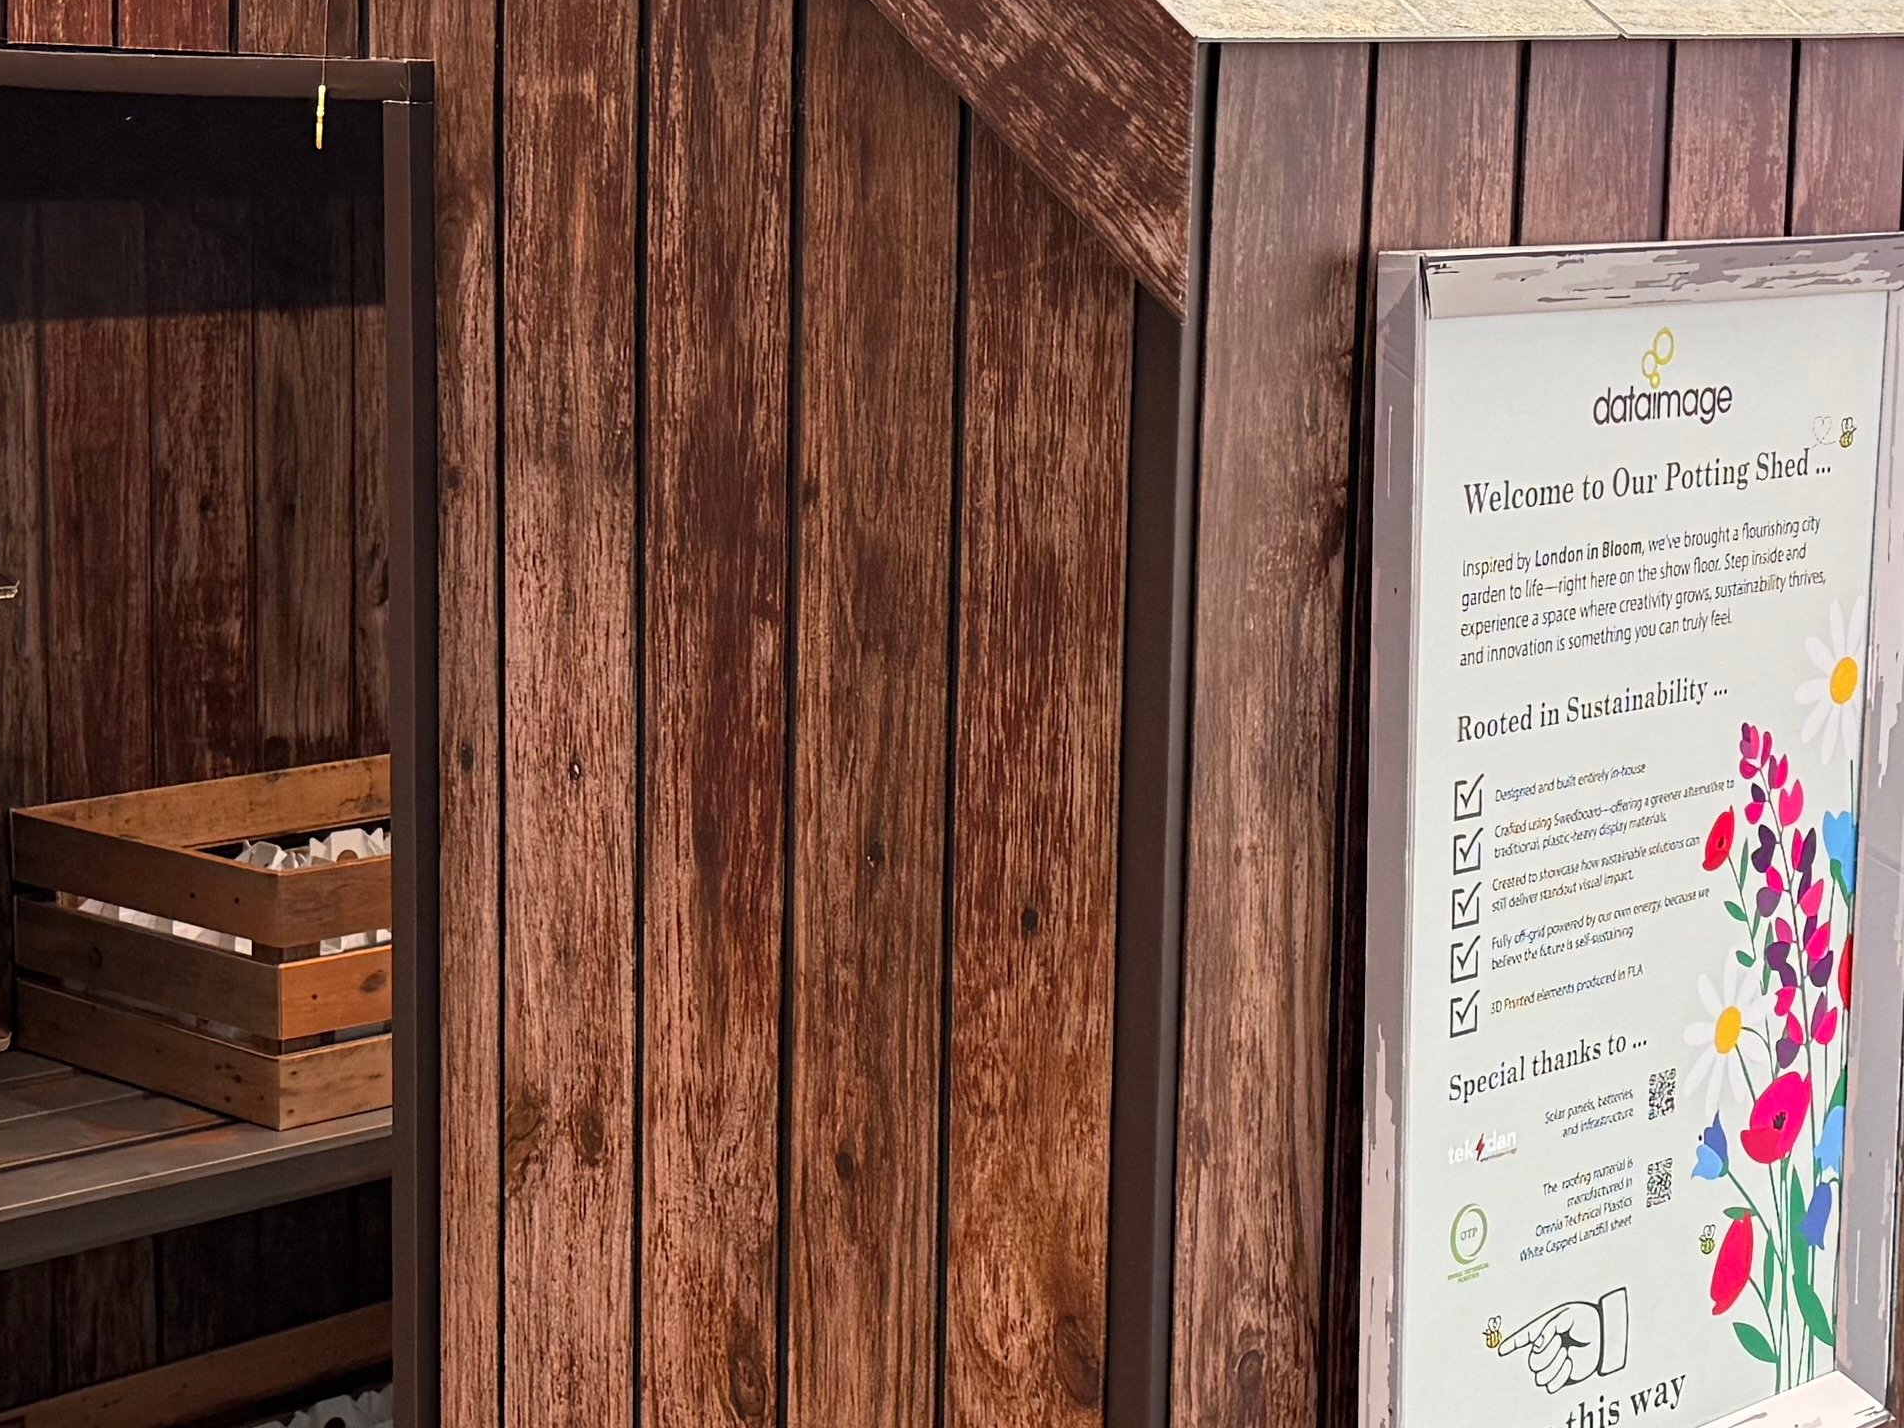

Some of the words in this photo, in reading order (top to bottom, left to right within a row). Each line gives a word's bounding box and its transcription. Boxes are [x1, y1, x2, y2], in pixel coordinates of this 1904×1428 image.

[1593, 385, 1733, 425] dataimage
[1464, 480, 1574, 515] Welcome
[1583, 475, 1604, 501] to
[1613, 467, 1658, 497] Our
[1665, 458, 1750, 491] Potting
[1756, 447, 1810, 481] Shed
[1463, 553, 1513, 579] Inspired
[1517, 552, 1531, 573] by
[1535, 546, 1583, 567] London
[1587, 543, 1598, 560] in
[1602, 540, 1645, 558] Bloom,
[1648, 534, 1681, 552] we've
[1684, 526, 1730, 549] brought
[1733, 527, 1739, 541] a
[1743, 519, 1799, 540] flourishing
[1802, 516, 1821, 535] city
[1461, 586, 1506, 612] garden
[1510, 584, 1521, 600] to
[1590, 571, 1616, 589] here
[1619, 570, 1634, 584] on
[1638, 565, 1657, 583] the
[1660, 562, 1690, 579] show
[1694, 556, 1720, 574] floor.
[1725, 552, 1749, 571] Step
[1751, 546, 1784, 566] inside
[1786, 542, 1807, 561] and
[1461, 614, 1529, 640] experience
[1532, 613, 1539, 626] a
[1542, 607, 1576, 627] space
[1580, 600, 1617, 618] where
[1619, 591, 1673, 615] creativity
[1675, 587, 1712, 610] grows,
[1715, 573, 1787, 600] sustainability
[1789, 570, 1826, 588] thrives,
[1460, 650, 1484, 667] and
[1487, 638, 1553, 663] innovation
[1557, 637, 1565, 652] is
[1568, 627, 1631, 649] something
[1634, 623, 1656, 643] you
[1659, 620, 1679, 636] can
[1683, 612, 1708, 632] truly
[1457, 704, 1532, 743] Rooted
[1540, 702, 1560, 728] in
[1566, 677, 1708, 723] Sustainability
[1495, 820, 1526, 838] Crafted
[1529, 816, 1552, 831] using
[1645, 798, 1648, 806] a
[1727, 780, 1734, 789] to
[1496, 782, 1536, 802] Designed
[1538, 778, 1554, 793] and
[1557, 774, 1576, 790] built
[1578, 768, 1608, 786] entirely
[1492, 873, 1526, 891] Created
[1528, 873, 1537, 883] to
[1581, 859, 1599, 871] how
[1686, 836, 1700, 847] can
[1492, 897, 1507, 912] still
[1509, 892, 1538, 908] deliver
[1540, 883, 1577, 901] standout
[1579, 874, 1602, 891] visual
[1492, 934, 1512, 950] Fully
[1547, 915, 1584, 938] powered
[1586, 914, 1596, 928] by
[1598, 912, 1612, 923] our
[1698, 888, 1710, 898] we
[1492, 954, 1522, 970] believe
[1524, 948, 1537, 962] the
[1540, 943, 1564, 957] future
[1567, 939, 1573, 950] is
[1576, 926, 1634, 949] self-sustaining
[1490, 1000, 1502, 1015] 3D
[1504, 991, 1534, 1011] Printed
[1537, 984, 1575, 1002] elements
[1577, 970, 1616, 994] produced
[1618, 969, 1625, 981] in
[1449, 1055, 1524, 1104] Special
[1532, 1039, 1601, 1077] thanks
[1608, 1034, 1626, 1056] to
[1545, 1109, 1565, 1124] Solar
[1563, 1125, 1578, 1138] and
[1544, 1182, 1558, 1195] The
[1562, 1172, 1591, 1189] roofing
[1627, 1156, 1634, 1168] is
[1626, 1177, 1632, 1188] in
[1630, 1374, 1686, 1417] way
